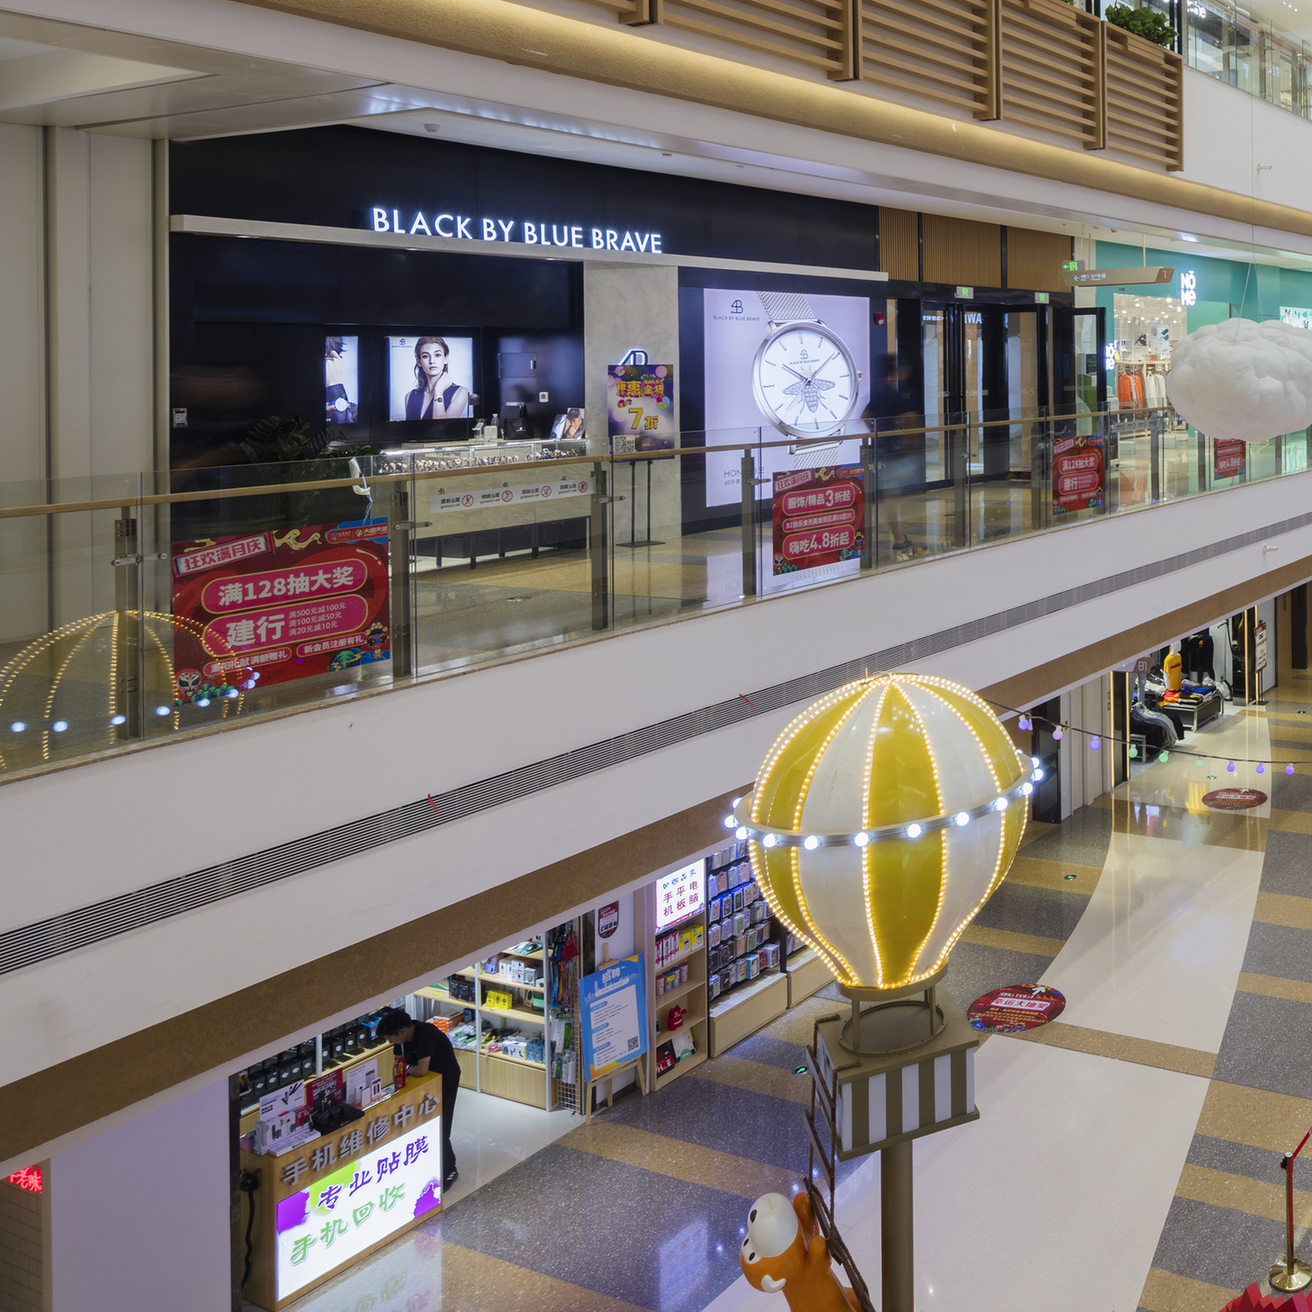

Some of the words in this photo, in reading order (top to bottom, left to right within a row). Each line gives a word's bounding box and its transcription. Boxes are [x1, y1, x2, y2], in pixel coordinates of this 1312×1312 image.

[372, 207, 473, 239] BLACK
[481, 218, 514, 243] BY
[523, 222, 584, 248] BLUE
[591, 228, 662, 254] BRAVE
[629, 407, 659, 429] 7折
[787, 490, 851, 509] 服饰/精品3折起
[789, 532, 849, 554] 嗨吃4.8折起
[184, 538, 262, 571] 狂欢满月庆
[218, 566, 354, 606] 满128抽大奖
[288, 601, 347, 619] 满500元减100元
[288, 611, 342, 628] 满100元减50元
[226, 614, 285, 648] 建行
[288, 620, 338, 637] 满20元减10元
[304, 635, 364, 654] 新会员注册有礼
[1138, 661, 1148, 672] B1
[601, 967, 621, 983] 招聘
[991, 998, 1049, 1009] 幸运大抽奖
[282, 1093, 440, 1187] 手机维修中心
[318, 1135, 429, 1209] 专业贴膜
[291, 1183, 405, 1264] 手机回收
